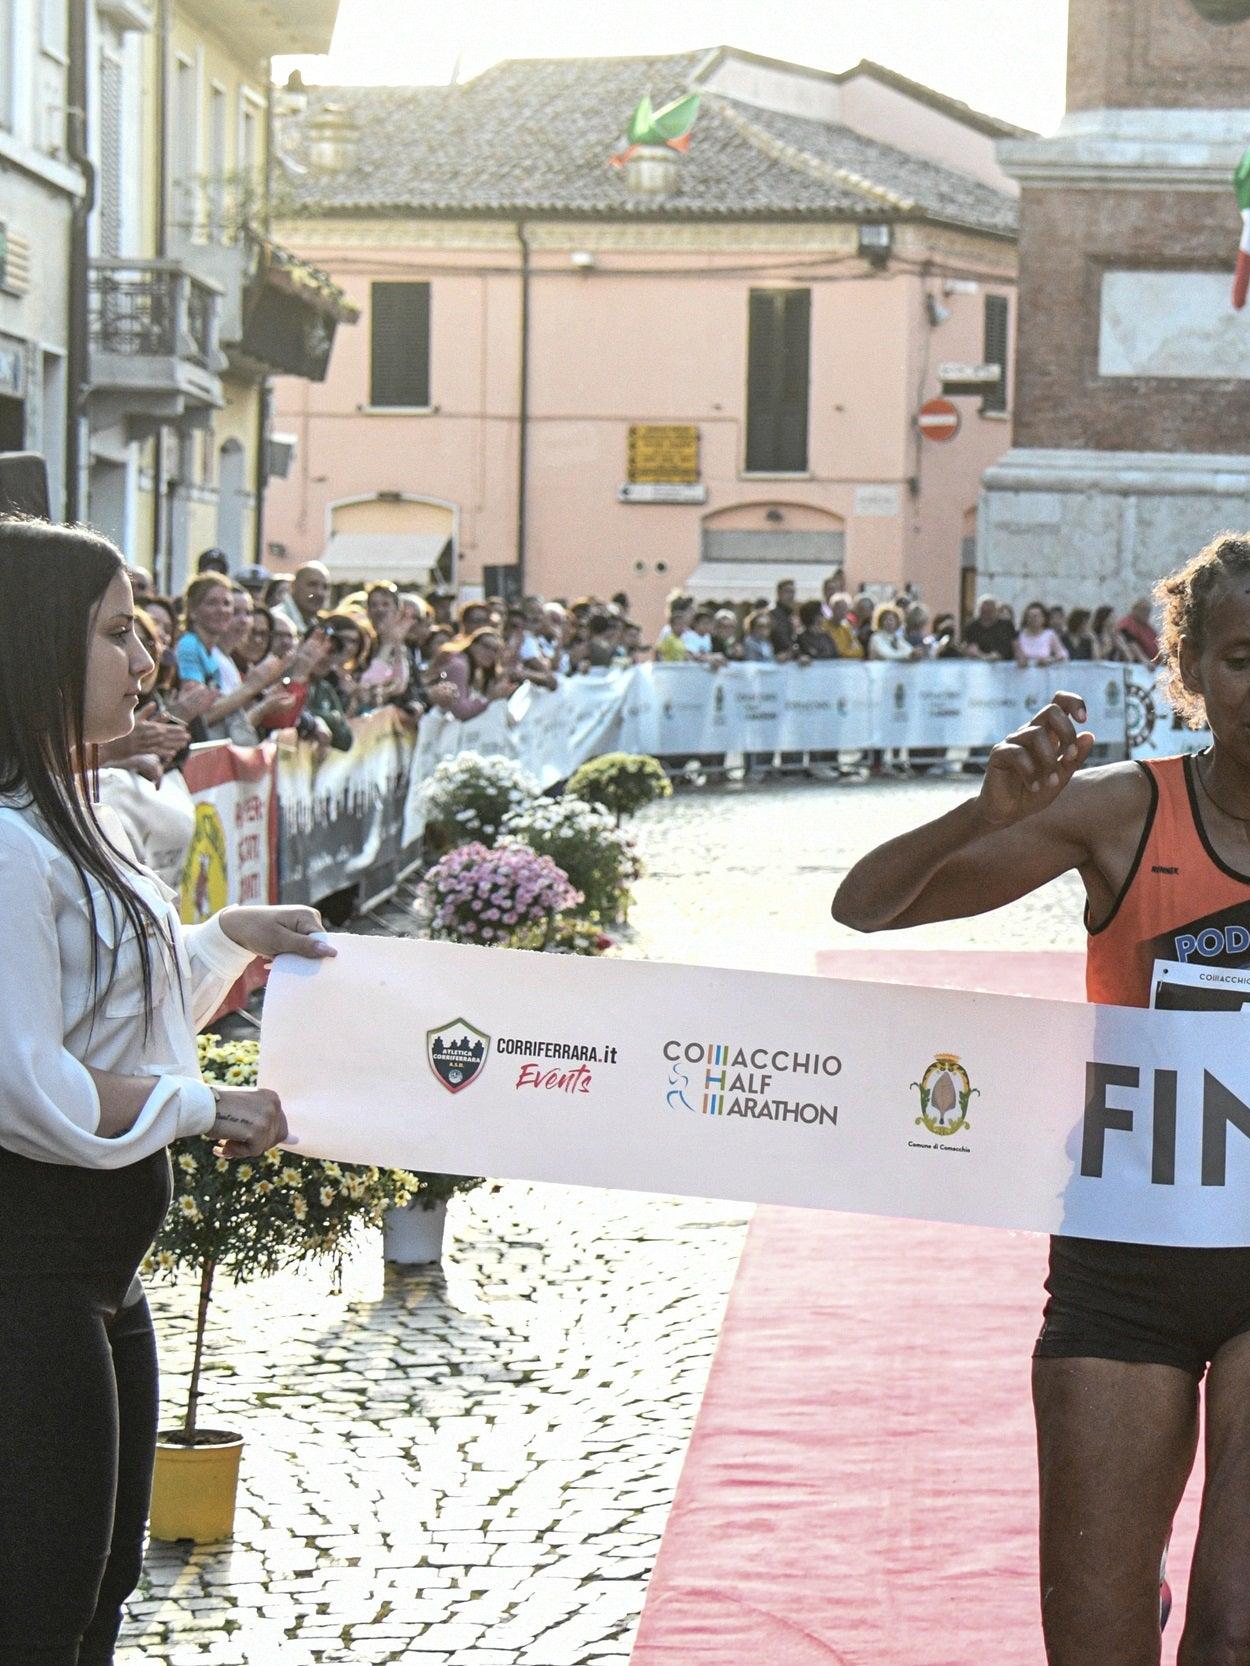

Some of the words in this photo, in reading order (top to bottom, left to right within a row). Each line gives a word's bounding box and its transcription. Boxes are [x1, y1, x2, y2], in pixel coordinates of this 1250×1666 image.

[496, 1037, 618, 1064] CORRIFERRARA.it
[515, 1063, 593, 1094] Events
[705, 1068, 772, 1095] HALF
[908, 1141, 931, 1149] Comune
[940, 1144, 970, 1153] Comacchio
